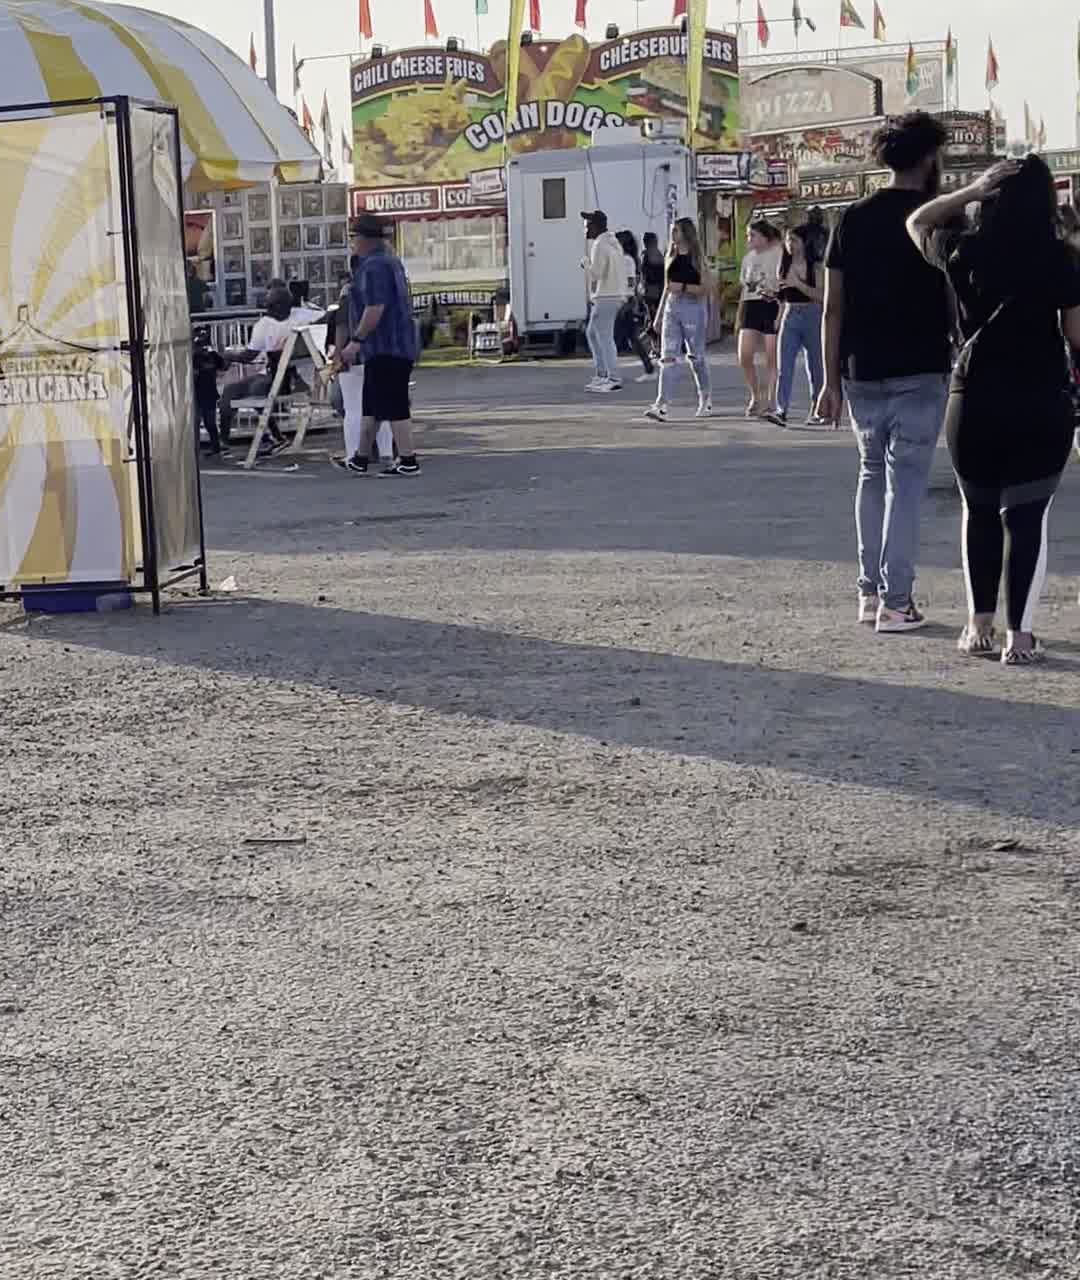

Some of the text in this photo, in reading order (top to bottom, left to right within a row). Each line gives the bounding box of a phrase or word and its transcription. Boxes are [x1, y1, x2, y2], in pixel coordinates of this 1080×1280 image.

[600, 36, 732, 70] CHEESEBURERS
[354, 55, 485, 92] CHILI CHEESE FRIES
[546, 100, 623, 132] DOGS
[755, 90, 832, 117] PIZZA
[365, 191, 432, 211] BURGERS
[801, 181, 856, 198] PIZZA
